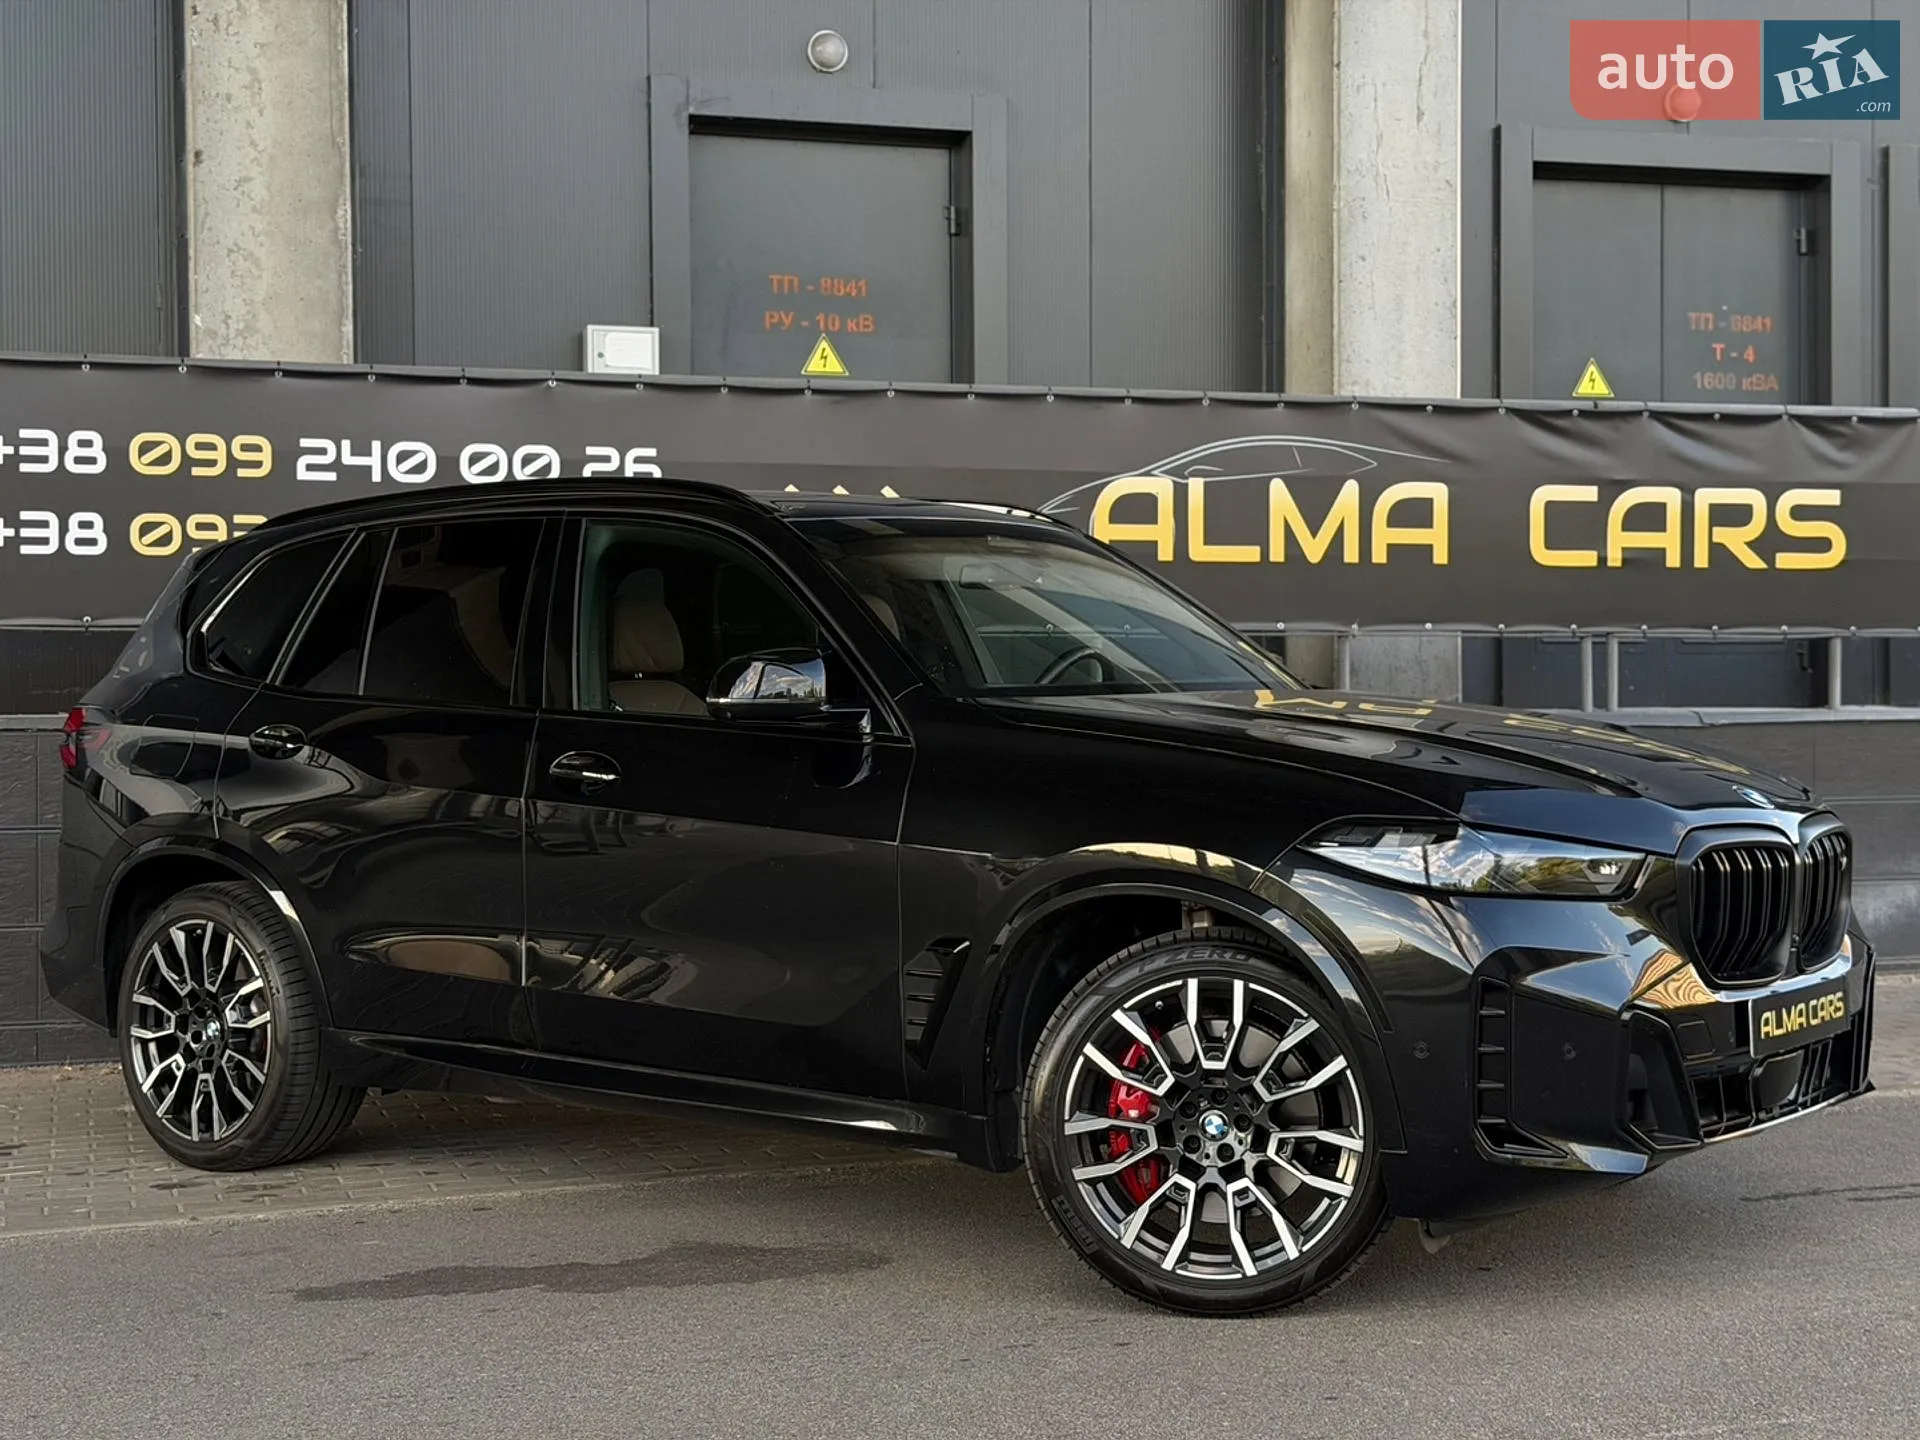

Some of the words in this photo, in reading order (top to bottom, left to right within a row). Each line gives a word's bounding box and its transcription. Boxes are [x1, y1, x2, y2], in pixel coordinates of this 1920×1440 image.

[815, 312, 841, 332] 10
[1743, 344, 1757, 364] 4
[129, 432, 273, 478] 099
[296, 437, 437, 483] 240
[459, 442, 561, 483] 00
[582, 446, 663, 478] 26
[1092, 477, 1449, 564] ALMA
[1529, 485, 1847, 570] CARS
[1760, 1003, 1807, 1040] ALMA
[1809, 991, 1845, 1026] CARS
